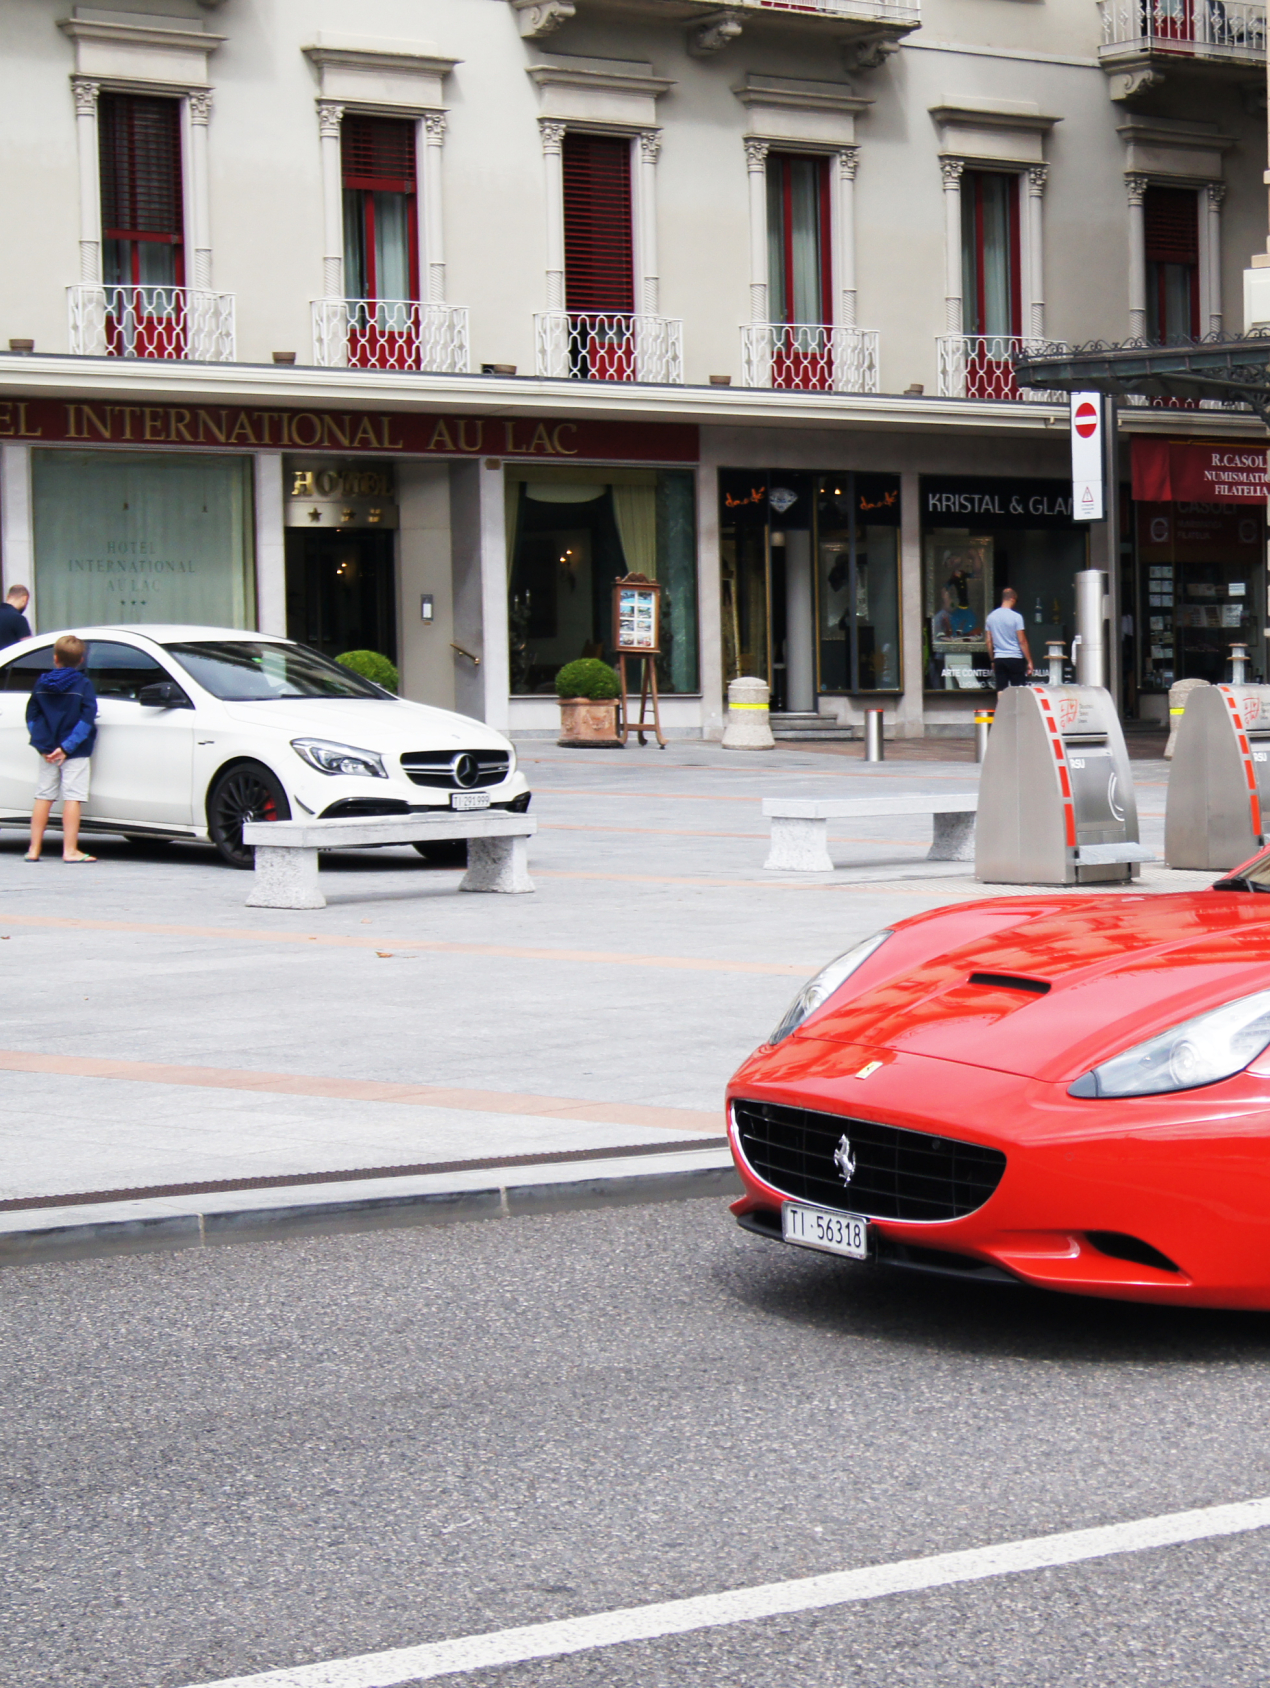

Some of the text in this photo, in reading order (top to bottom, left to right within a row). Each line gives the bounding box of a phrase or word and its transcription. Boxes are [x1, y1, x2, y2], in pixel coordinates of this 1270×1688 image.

[64, 404, 403, 449] INTERNATIONAL
[425, 419, 485, 451] AU
[502, 421, 579, 454] LAC
[1211, 453, 1267, 468] R.CASOL
[1204, 470, 1270, 483] NUMISMATIC
[1214, 484, 1269, 497] FILATELIA
[928, 493, 1005, 513] KRISTAL
[1009, 495, 1024, 514] &
[107, 541, 156, 554] HOTEL
[68, 559, 195, 573] INTERNATIONAL
[106, 578, 161, 592] AU LAC
[941, 669, 961, 677] ARTE
